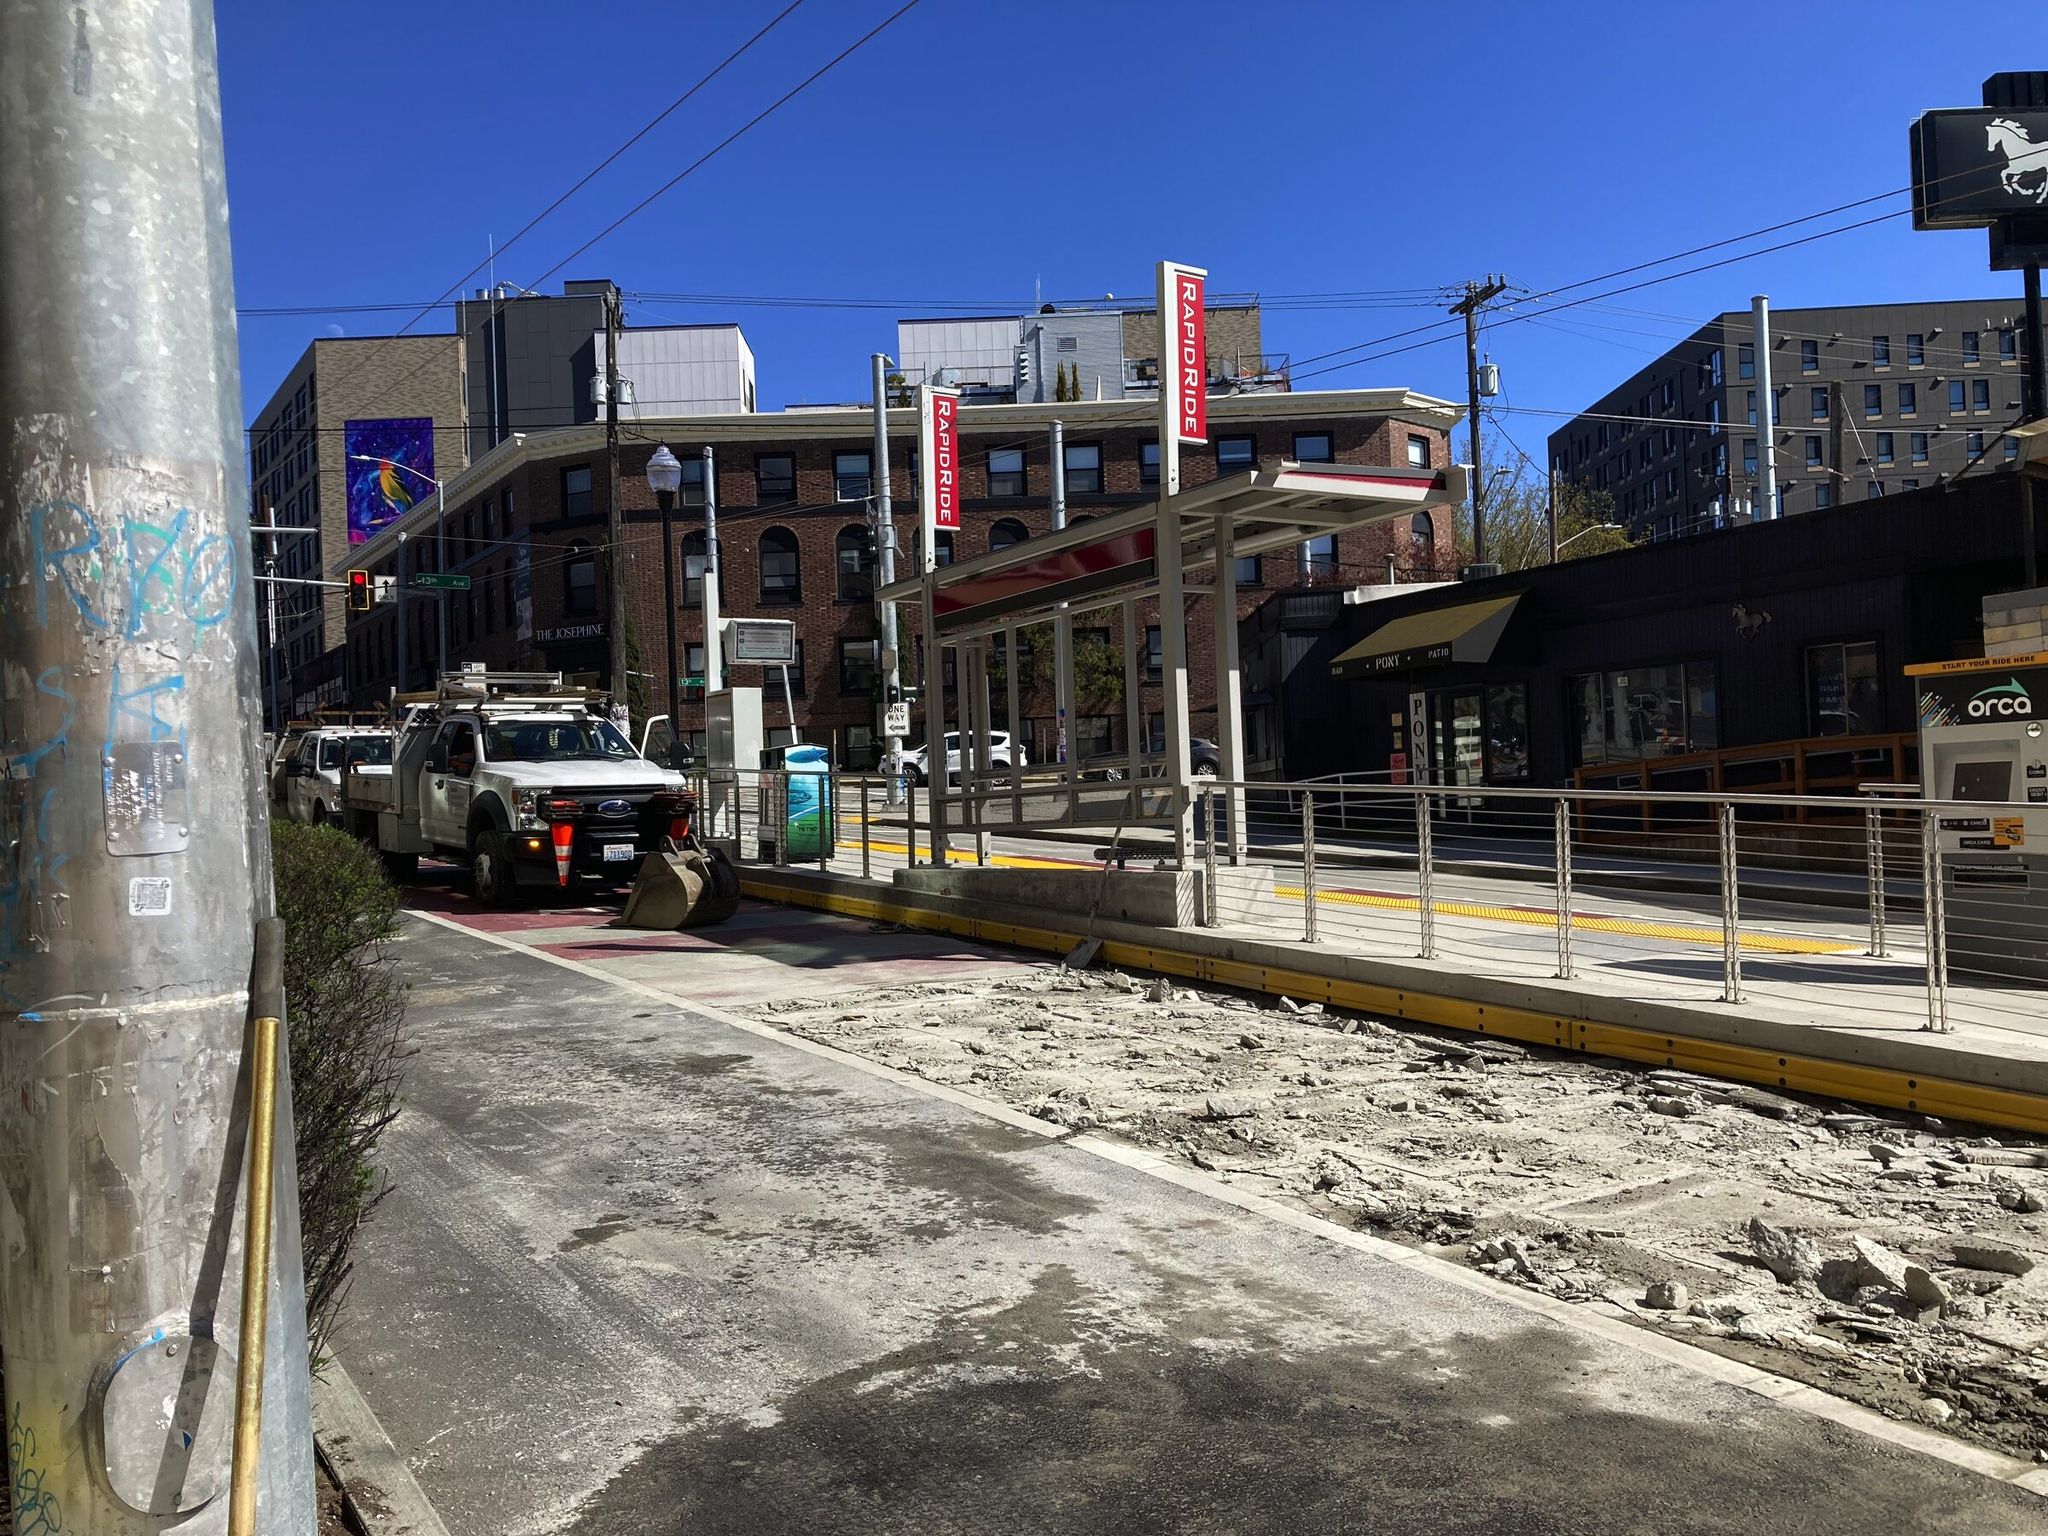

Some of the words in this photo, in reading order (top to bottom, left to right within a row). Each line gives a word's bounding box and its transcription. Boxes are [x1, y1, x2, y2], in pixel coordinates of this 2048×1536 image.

[1182, 282, 1198, 433] RAPIDRIDE
[939, 400, 952, 522] RAPIDRIDE
[536, 630, 553, 641] THE
[555, 624, 604, 639] JOSEPHINE
[1375, 654, 1400, 670] PONY
[1428, 648, 1449, 660] PATIO
[1941, 662, 1966, 670] START
[1968, 660, 1991, 668] YOUR
[888, 704, 905, 713] ONE
[1967, 696, 2032, 717] orca
[888, 714, 905, 722] WAY
[1413, 699, 1425, 780] PONY
